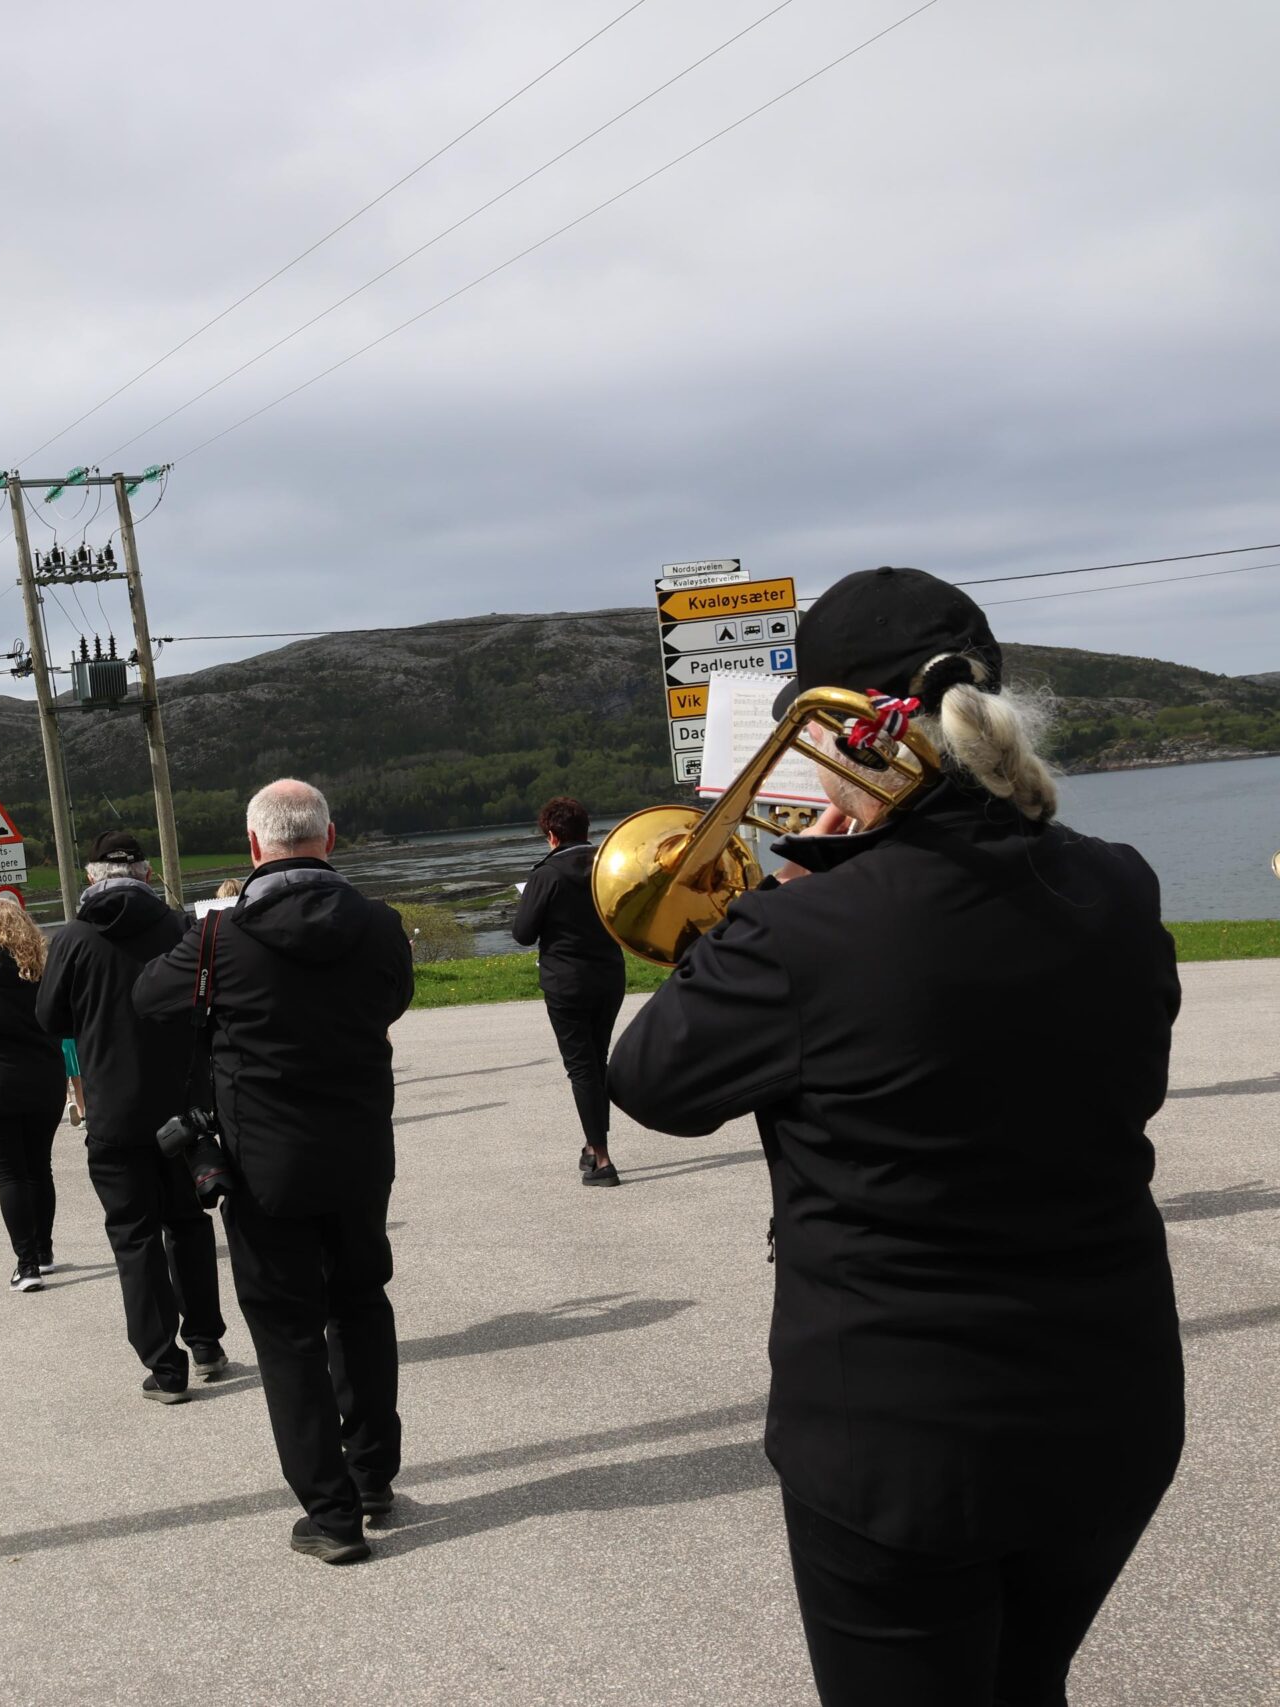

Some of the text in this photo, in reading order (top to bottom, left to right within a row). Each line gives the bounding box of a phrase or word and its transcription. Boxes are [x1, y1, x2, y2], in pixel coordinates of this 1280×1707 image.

[672, 563, 723, 574] Nordsjøveien
[673, 575, 740, 587] Kvaløyseterveien
[688, 589, 786, 610] Kvaløysæter
[690, 651, 788, 674] Padlerute P
[676, 694, 702, 709] Vik
[199, 968, 209, 996] Canon
